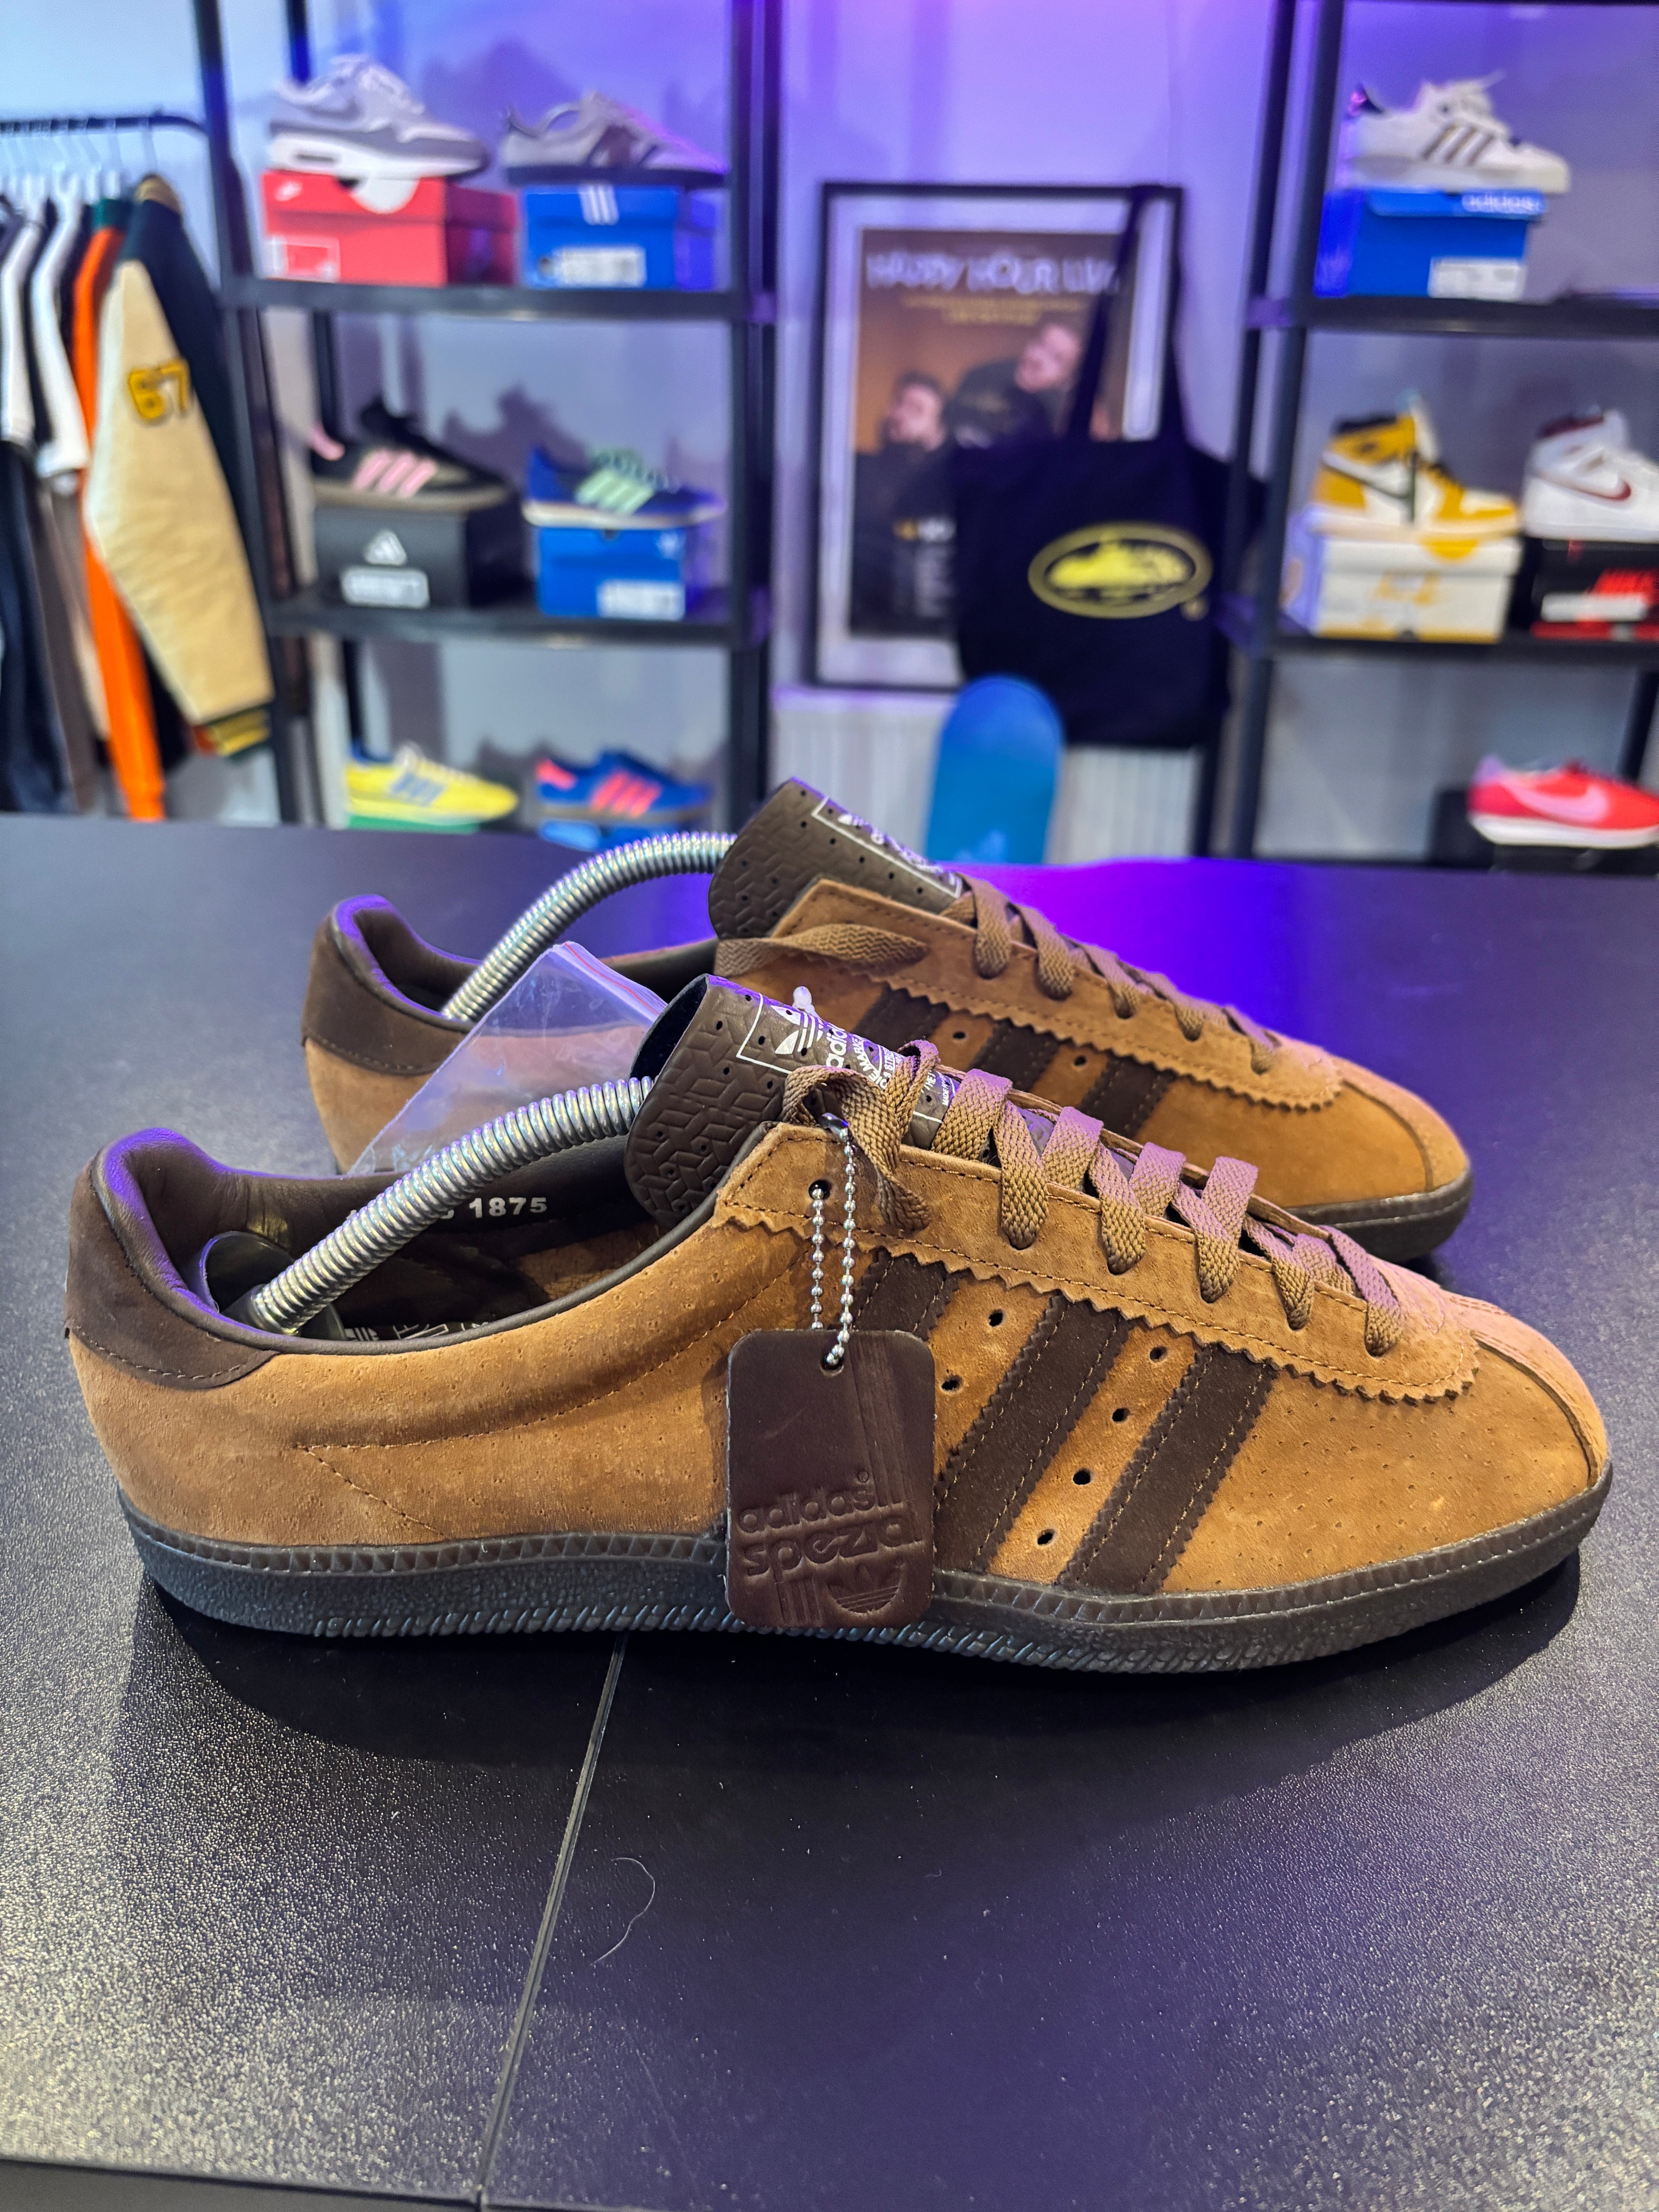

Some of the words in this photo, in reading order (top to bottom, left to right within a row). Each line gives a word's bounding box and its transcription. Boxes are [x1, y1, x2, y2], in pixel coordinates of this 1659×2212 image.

[866, 251, 966, 291] HAPPY
[967, 252, 1060, 295] HOUR
[1062, 256, 1120, 295] LIV
[127, 360, 189, 419] 67
[826, 1022, 848, 1068] adid
[469, 1197, 547, 1218] 1875
[737, 1486, 877, 1534] adidas
